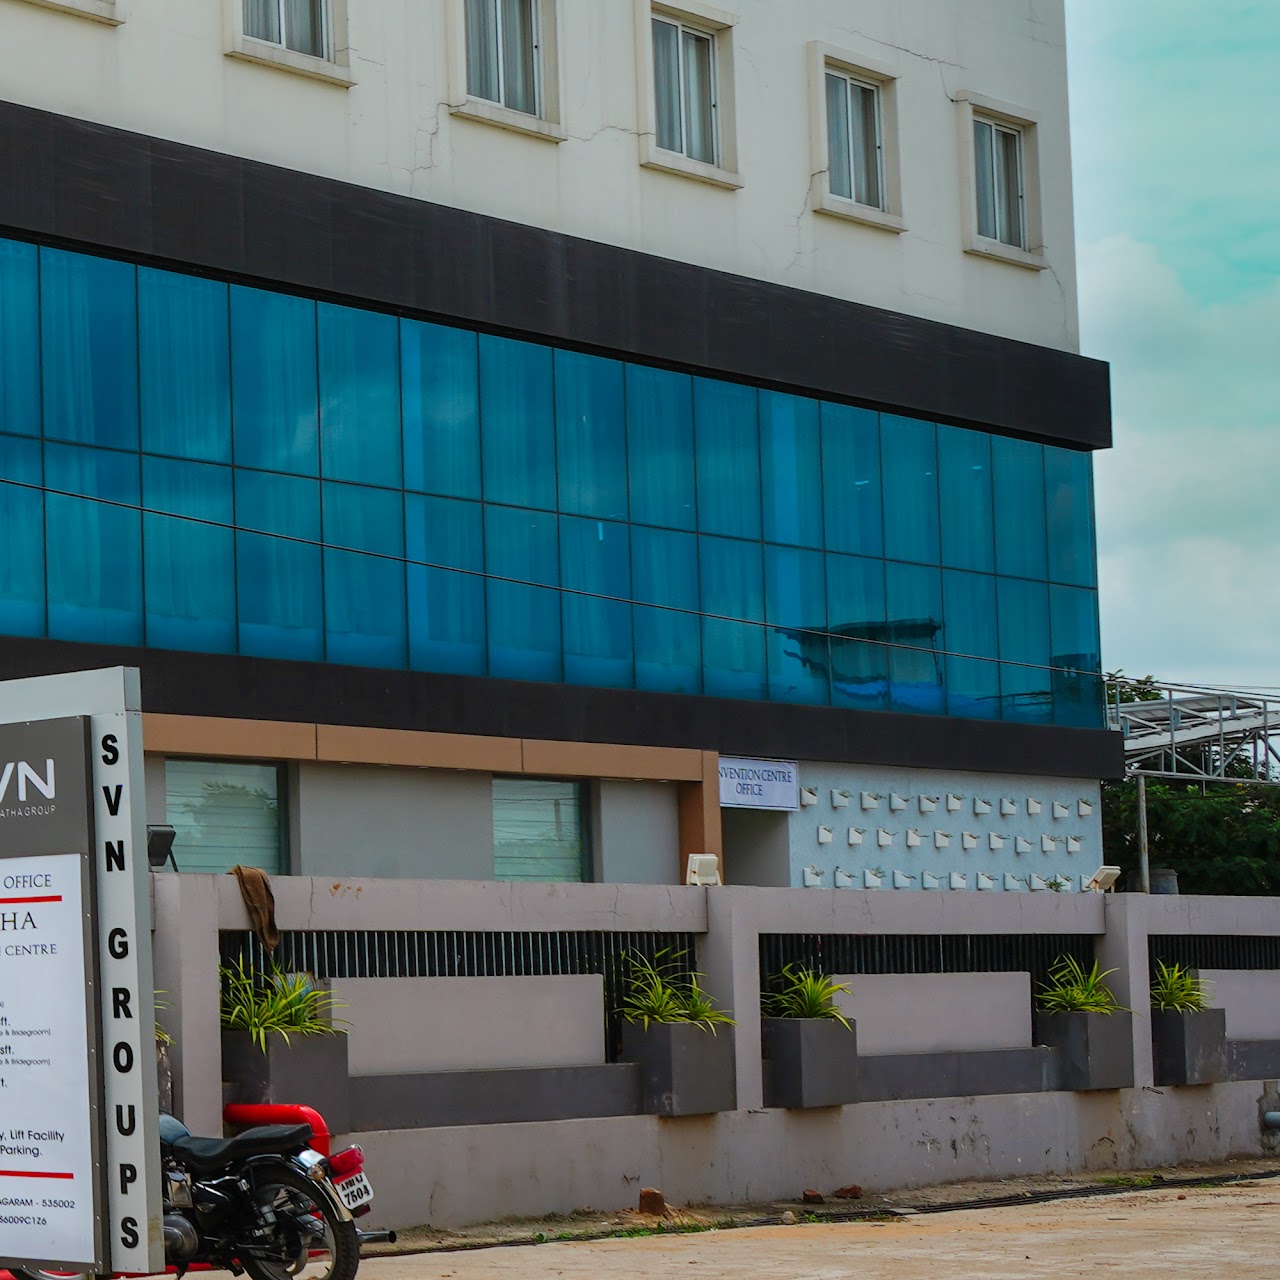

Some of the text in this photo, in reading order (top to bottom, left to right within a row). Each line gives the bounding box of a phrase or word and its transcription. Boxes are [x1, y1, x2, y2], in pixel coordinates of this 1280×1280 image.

[761, 769, 792, 782] CENTRE
[735, 782, 763, 796] OFFICE
[101, 734, 126, 872] SVN
[24, 804, 57, 816] GROUP
[3, 874, 52, 889] OFFICE
[5, 943, 57, 956] CENTRE
[0, 1045, 15, 1055] sft.
[108, 928, 139, 1249] GROUPS
[10, 1129, 24, 1140] Lift
[28, 1130, 65, 1143] Facility
[0, 1145, 43, 1157] Parking.
[344, 1184, 370, 1205] 7504
[42, 1199, 75, 1209] 535002
